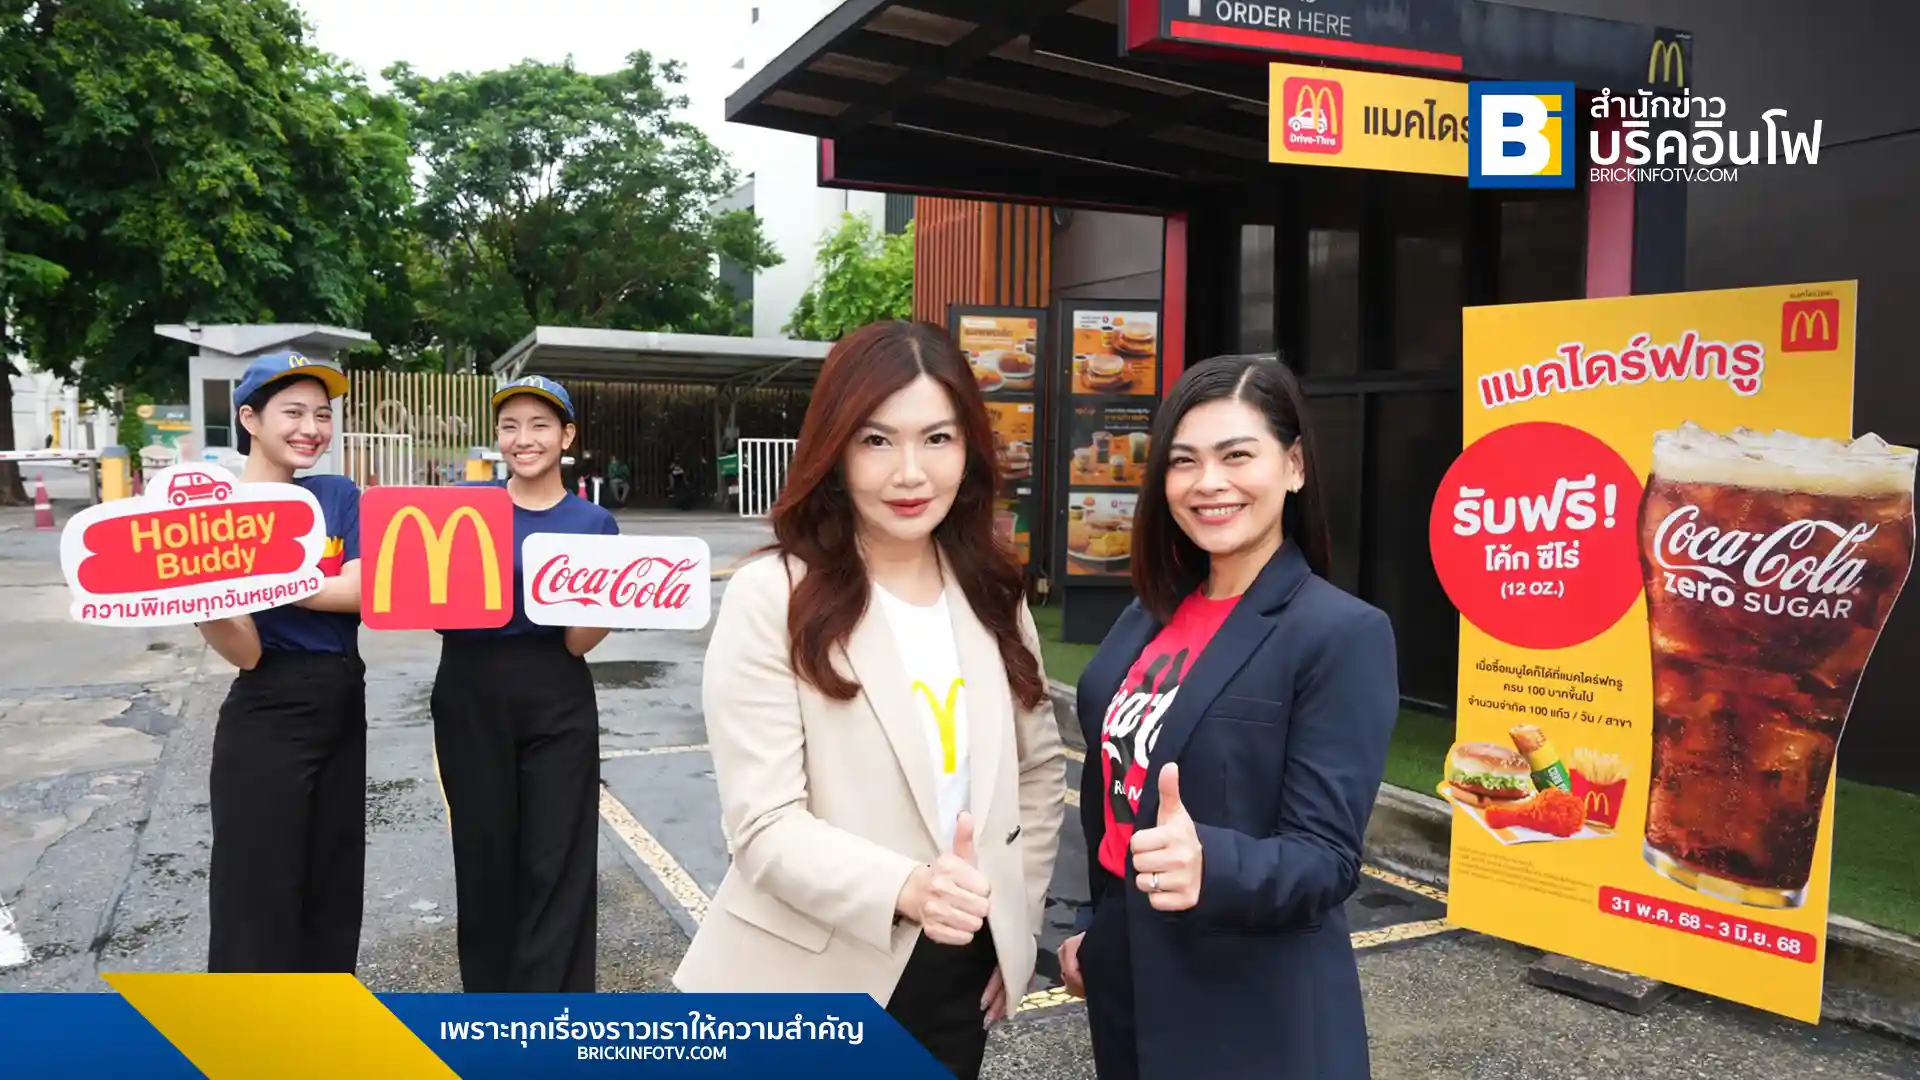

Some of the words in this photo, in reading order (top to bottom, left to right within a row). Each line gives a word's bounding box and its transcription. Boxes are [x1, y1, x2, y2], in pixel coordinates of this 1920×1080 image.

[1216, 0, 1291, 29] ORDER
[1298, 12, 1352, 37] HERE
[1480, 331, 1762, 406] แมคไดร์ฟทรู
[131, 508, 276, 553] Holiday
[1654, 505, 1880, 595] Coca-Cola
[156, 544, 257, 580] Buddy
[1484, 544, 1530, 572] โค้ก
[1537, 540, 1580, 570] ซีโร่
[81, 575, 319, 620] ความพิเศษทุกวันหยุดยาว
[532, 554, 701, 610] Coca-Cola
[1500, 581, 1526, 600] (12
[1530, 580, 1565, 598] OZ.)
[1663, 571, 1736, 608] zero
[1743, 592, 1853, 620] SUGAR
[1468, 695, 1526, 714] จำนวนจำกัด
[1530, 705, 1548, 717] 100
[1550, 706, 1570, 720] แก้ว
[1580, 710, 1595, 724] วัน
[1605, 716, 1632, 729] สาขา
[1503, 681, 1524, 694] ครบ
[1528, 685, 1546, 697] 100
[1548, 687, 1594, 704] บาทขึ้นไป
[1611, 896, 1631, 913] 31
[1636, 904, 1673, 924] พ.ค.
[1679, 912, 1701, 930] 68
[1719, 921, 1730, 937] 3
[1735, 923, 1772, 948] มิ.ย.
[1777, 936, 1800, 955] 68
